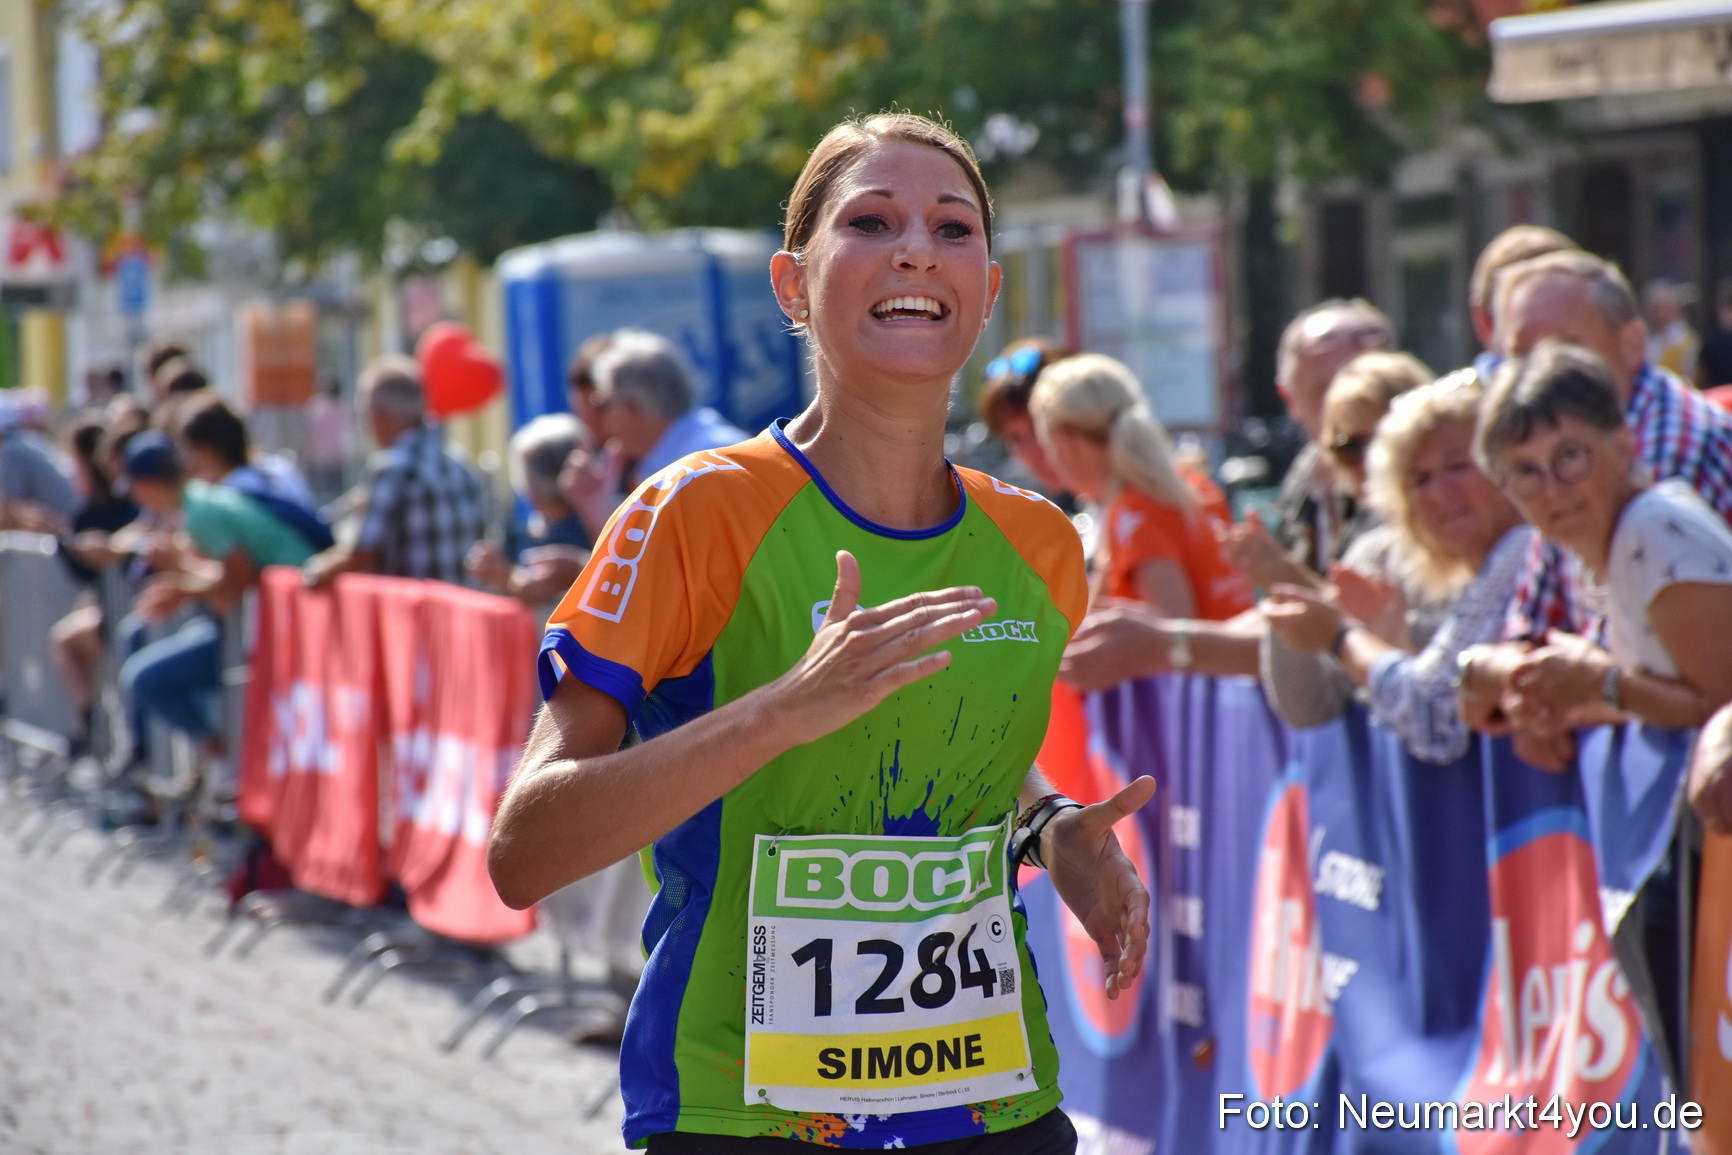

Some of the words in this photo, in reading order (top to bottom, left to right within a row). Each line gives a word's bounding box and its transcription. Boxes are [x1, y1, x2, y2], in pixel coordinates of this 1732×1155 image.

[961, 620, 1039, 642] BOCK
[991, 921, 1002, 936] C
[790, 922, 998, 1017] 1284
[817, 1033, 985, 1080] SIMONE
